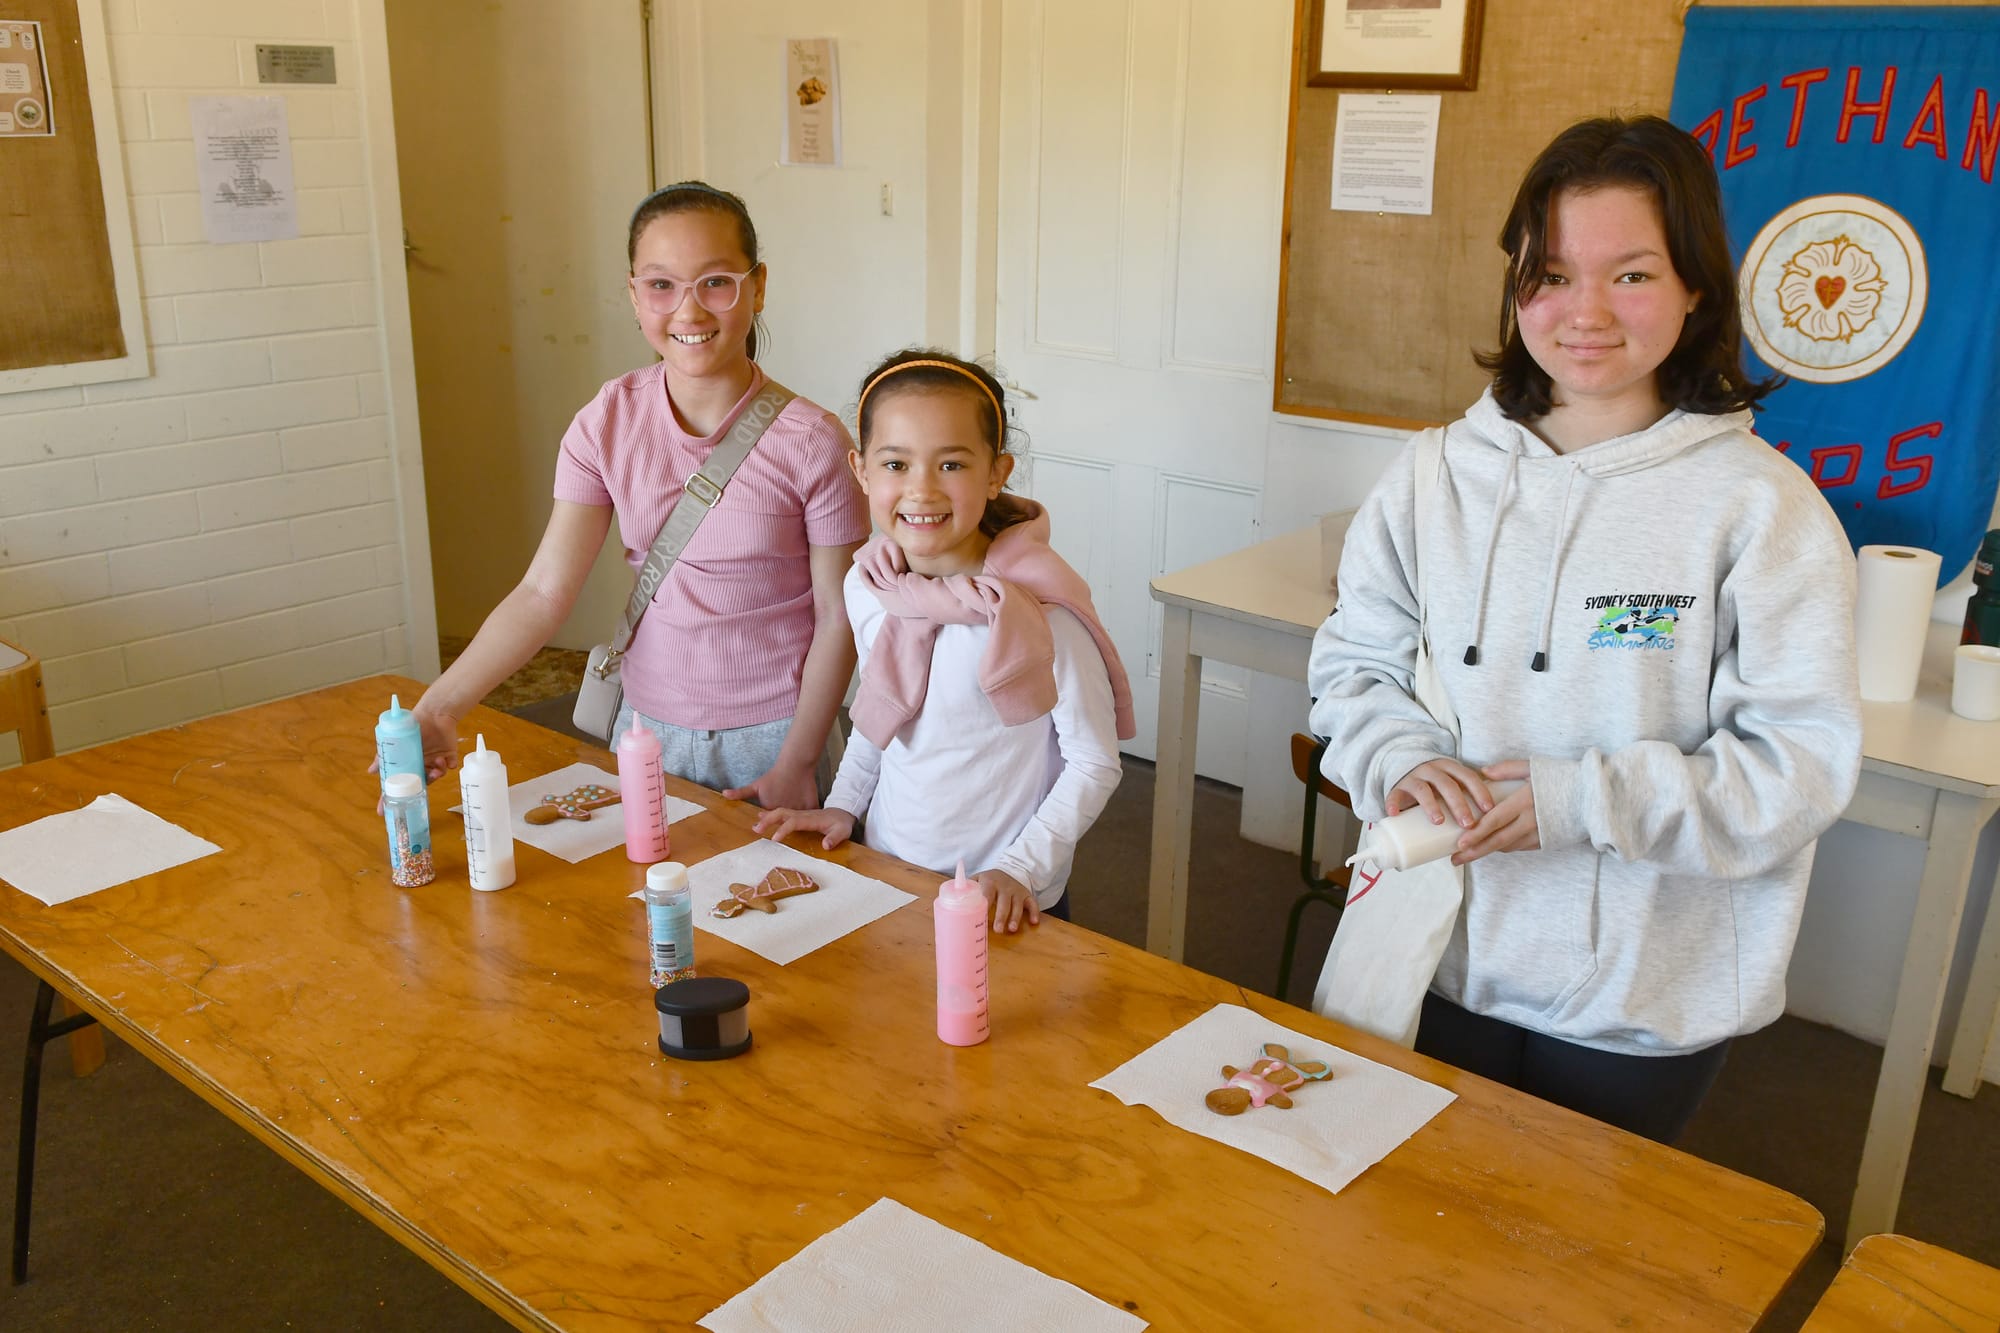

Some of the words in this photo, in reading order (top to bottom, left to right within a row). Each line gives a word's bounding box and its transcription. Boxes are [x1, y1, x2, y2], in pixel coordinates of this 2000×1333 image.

[734, 391, 786, 445] ROAD
[630, 561, 662, 617] ROAD
[1584, 594, 1627, 610] SYDNEY
[1626, 594, 1666, 609] SOUTH
[1665, 594, 1697, 609] WEST
[1587, 632, 1675, 651] SWIMMING
